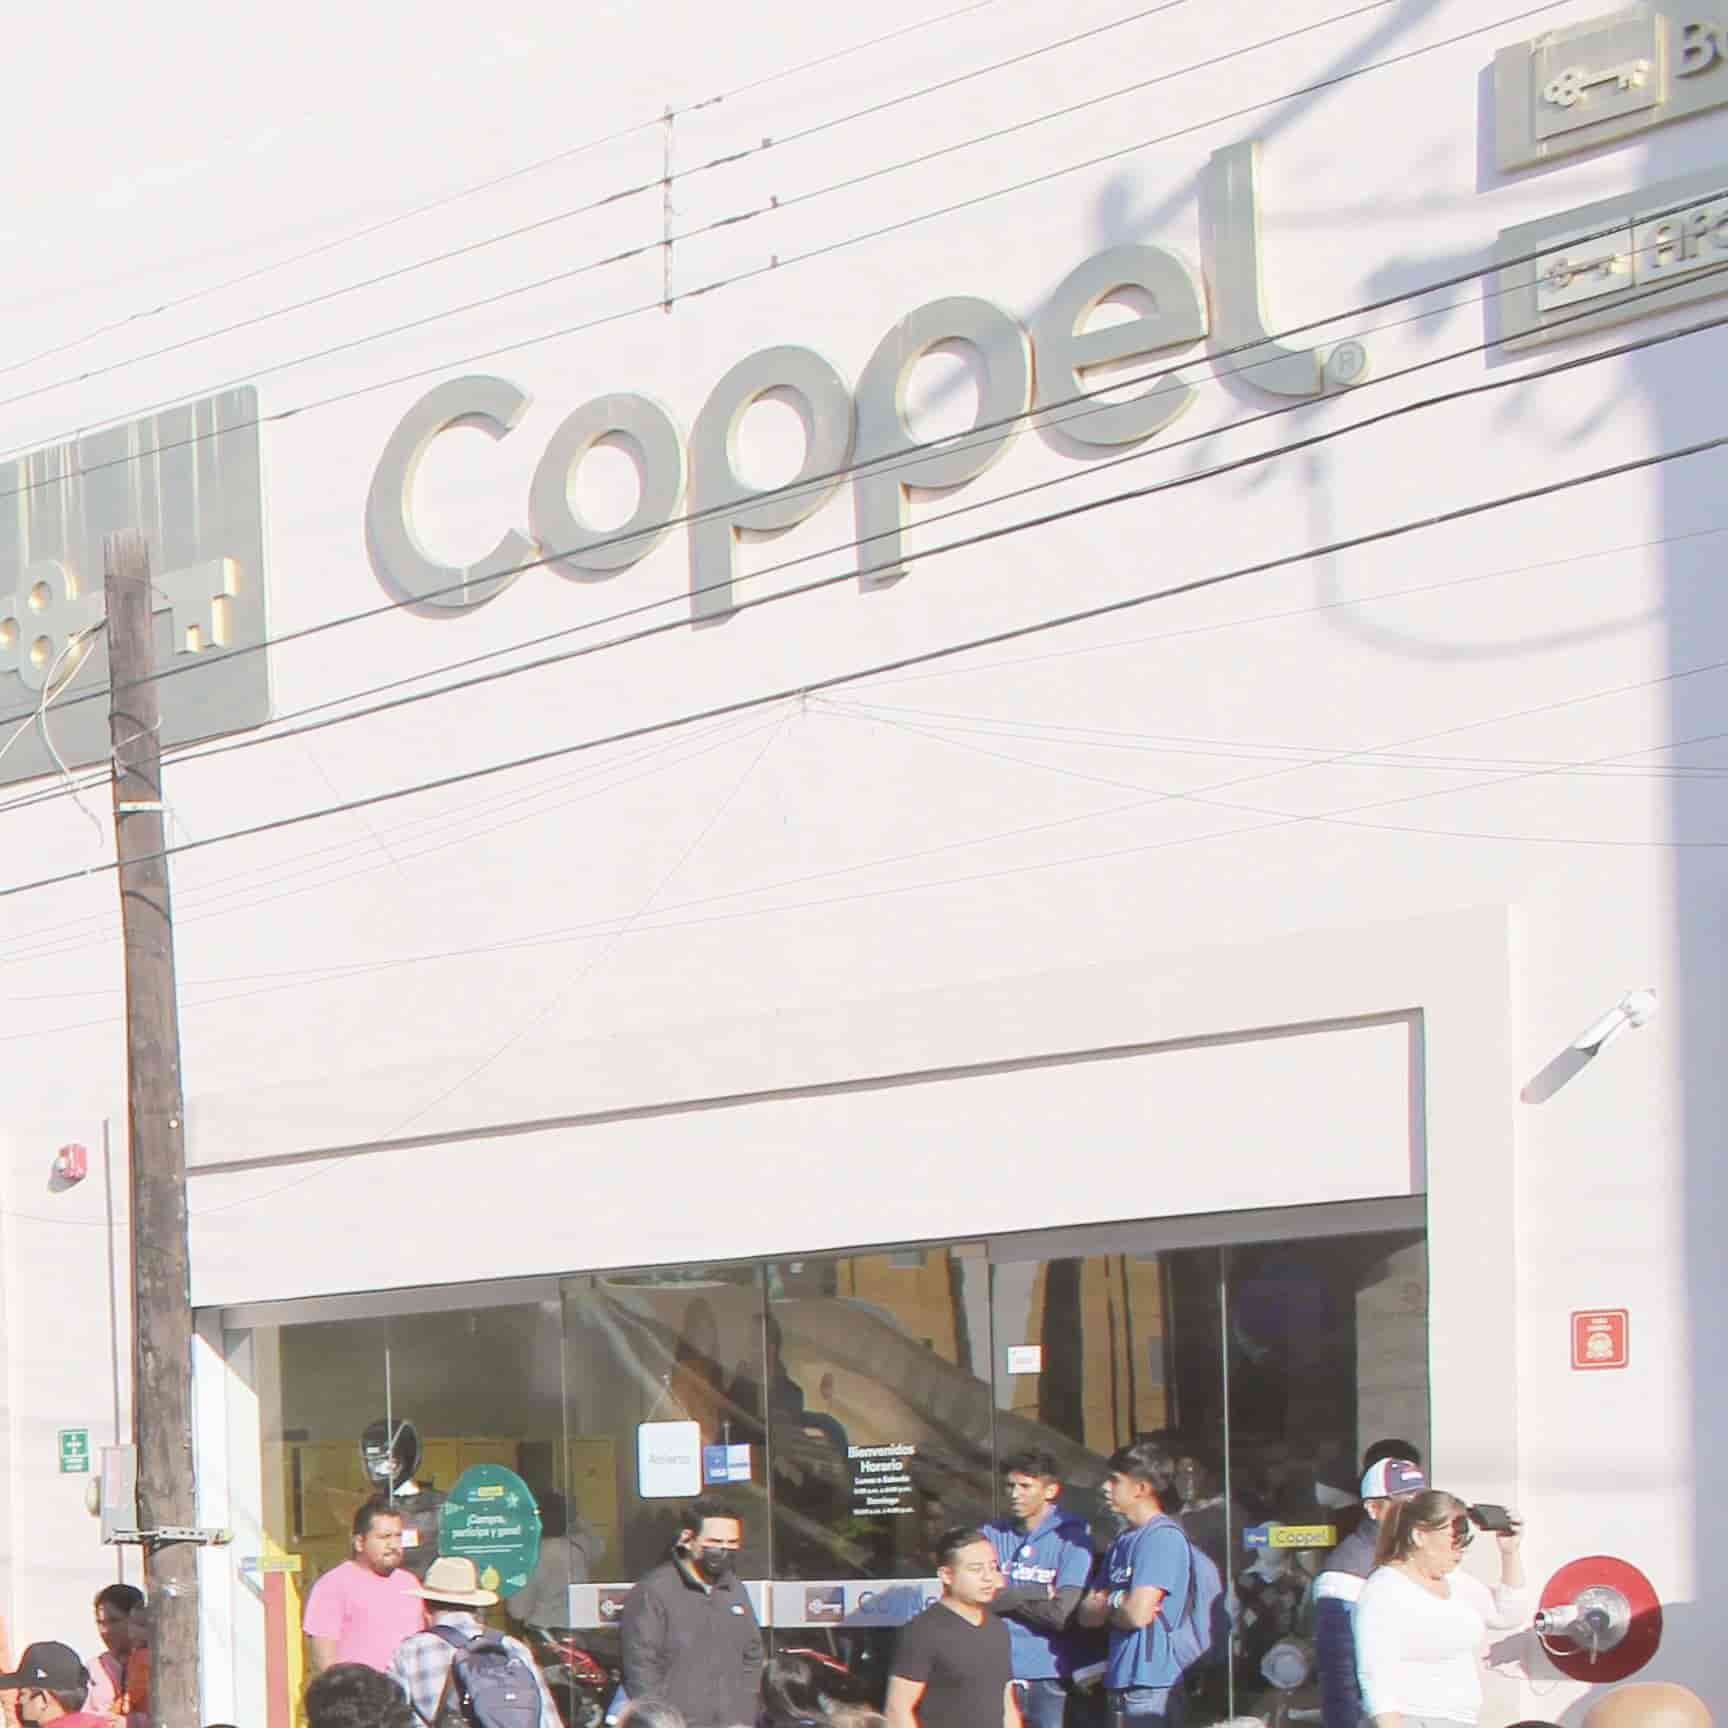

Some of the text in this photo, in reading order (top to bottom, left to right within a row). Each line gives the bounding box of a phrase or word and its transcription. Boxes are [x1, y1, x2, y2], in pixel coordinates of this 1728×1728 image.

[366, 140, 1321, 627] Coppel
[860, 1458, 904, 1472] Horario
[1276, 1529, 1329, 1545] Coppel
